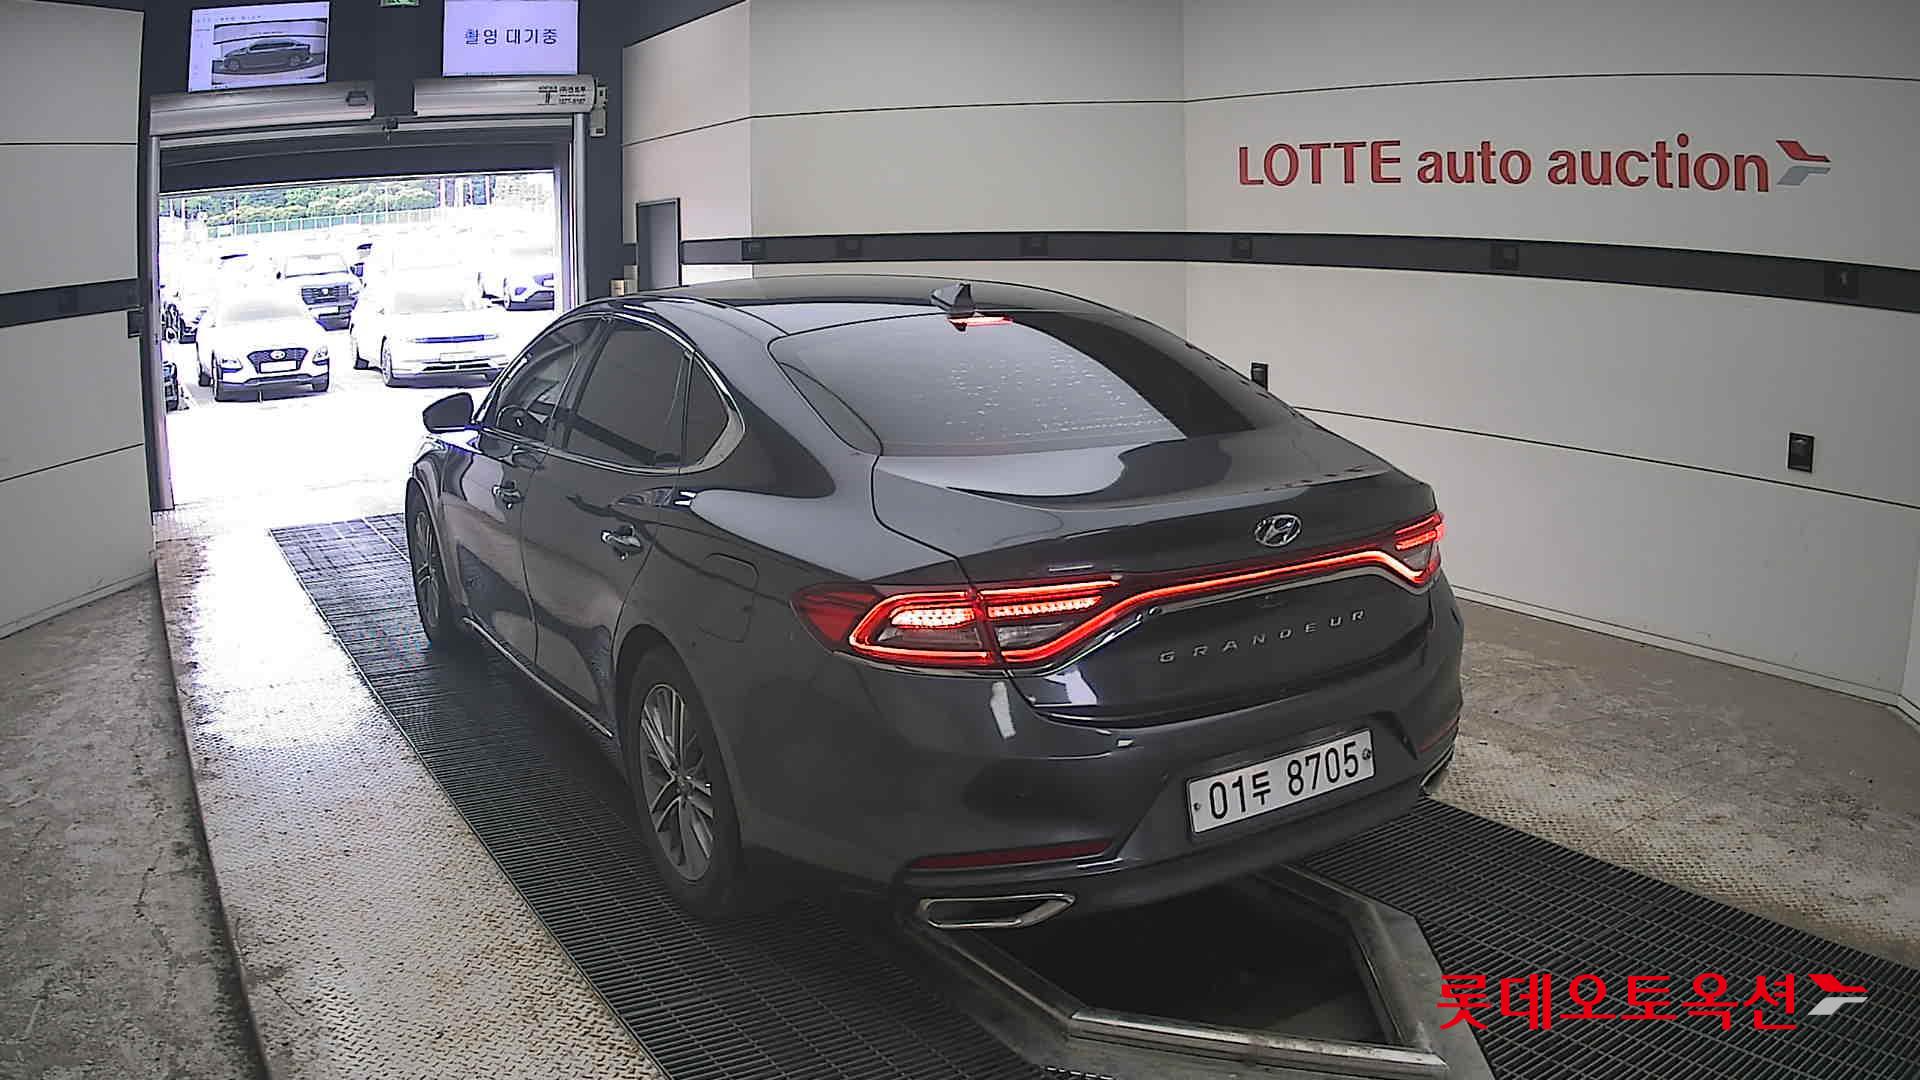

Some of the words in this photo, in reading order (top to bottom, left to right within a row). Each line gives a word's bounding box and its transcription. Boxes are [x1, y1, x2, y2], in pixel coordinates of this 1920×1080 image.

[505, 28, 558, 46] 대기중
[1239, 140, 1402, 186] LOTTE
[1416, 140, 1532, 185] auto
[1547, 133, 1770, 192] auction
[1159, 609, 1365, 663] GRANDEUR
[1209, 771, 1271, 820] 01두
[1287, 741, 1359, 796] 8705
